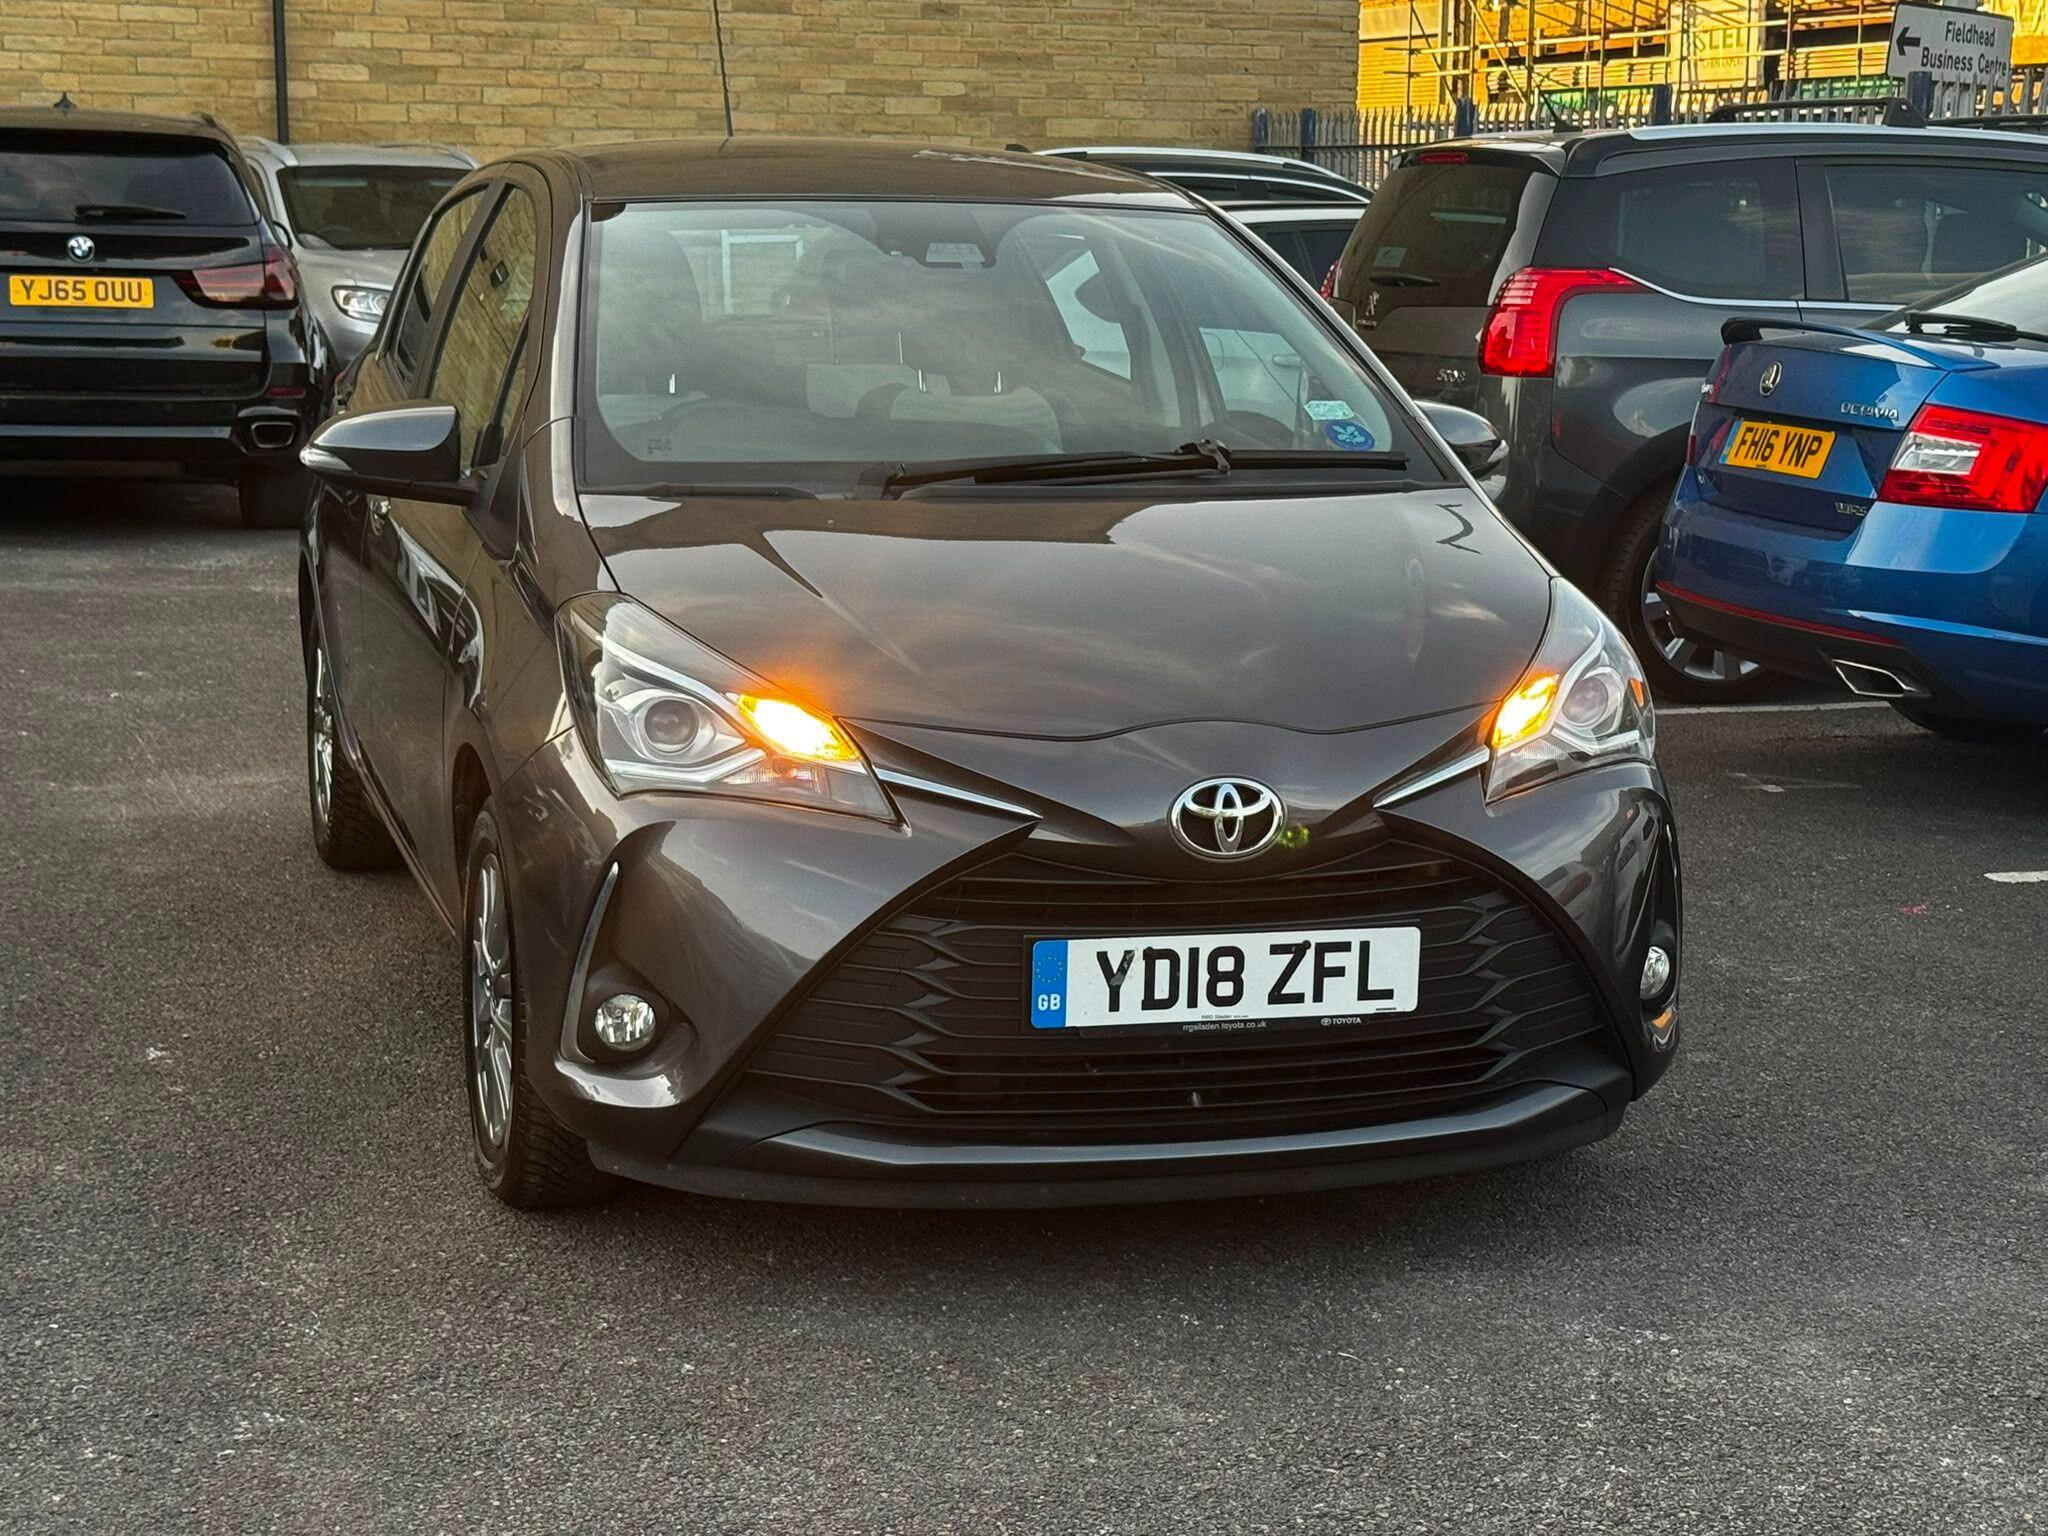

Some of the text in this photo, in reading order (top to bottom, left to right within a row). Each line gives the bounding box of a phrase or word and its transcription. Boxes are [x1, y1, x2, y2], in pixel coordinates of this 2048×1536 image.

[1945, 21, 1996, 47] Fieldhead
[1921, 46, 2007, 76] Business Centre
[20, 279, 143, 302] YJ65 OUU
[1734, 427, 1823, 469] FH16 YNP
[1096, 940, 1395, 1012] YD18 ZFL
[1038, 993, 1060, 1011] GB
[1332, 1017, 1362, 1025] TOYOTA
